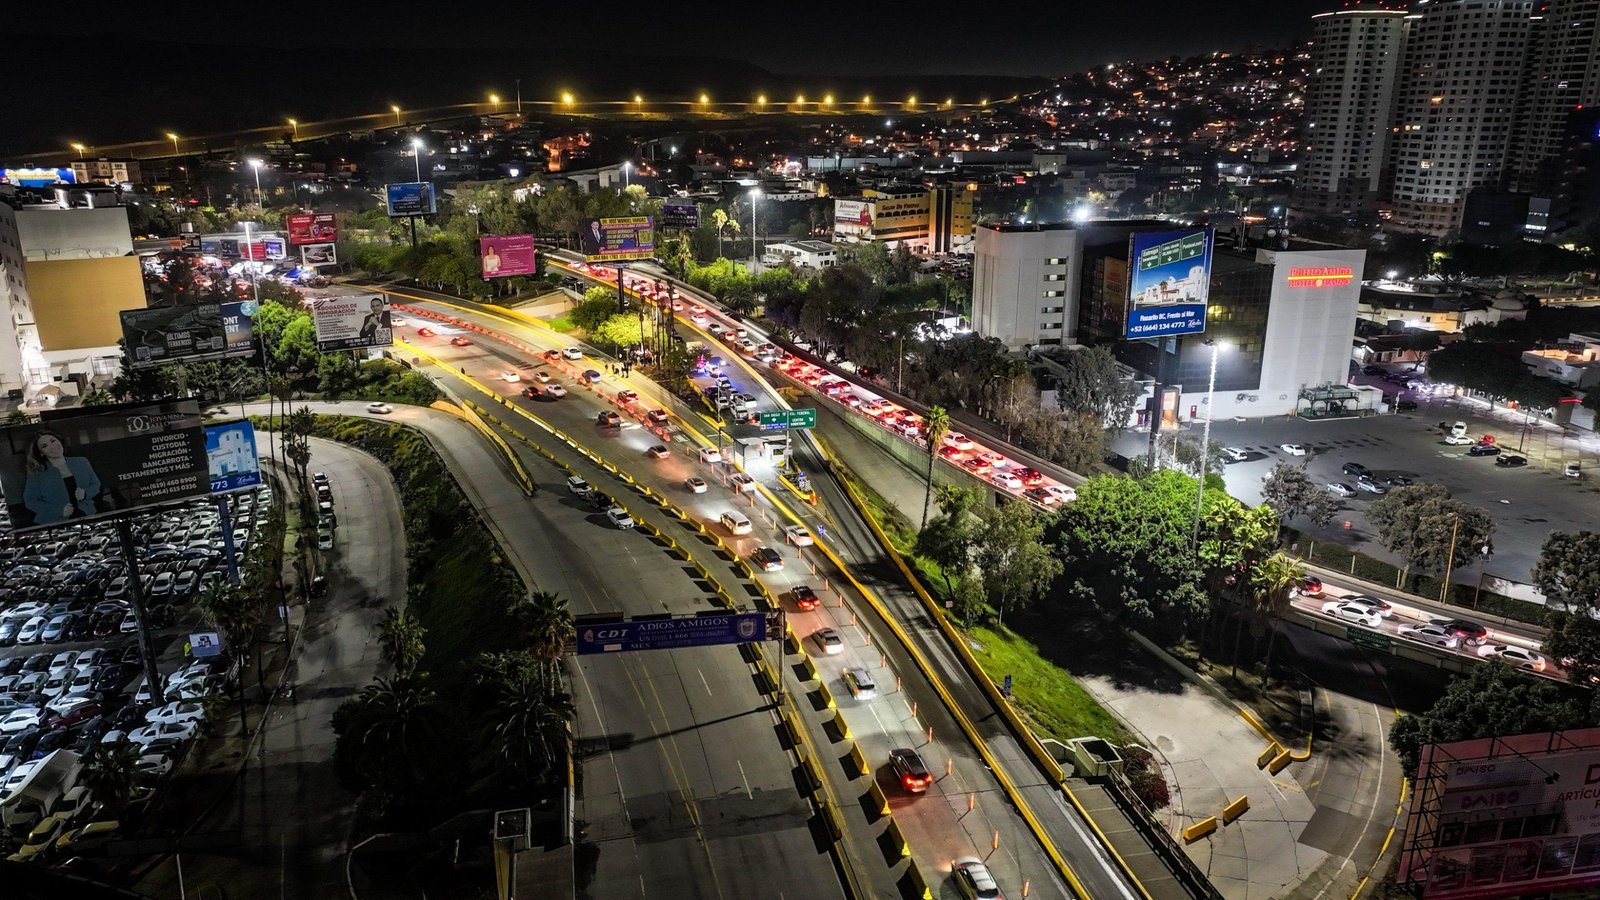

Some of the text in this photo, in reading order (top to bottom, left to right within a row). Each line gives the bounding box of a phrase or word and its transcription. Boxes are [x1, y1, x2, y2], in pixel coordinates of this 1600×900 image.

[1291, 267, 1352, 276] PUEBLO AMIGO
[152, 432, 186, 444] DIVORCIO
[152, 441, 187, 452] CUSTODIA
[149, 448, 188, 460] MIGRACIÓN
[142, 456, 190, 469] BANCARROTA
[118, 467, 170, 481] TESTAMENTOS
[176, 462, 191, 470] MÁS
[150, 482, 167, 492] (619)
[180, 476, 197, 485] 8900
[211, 480, 228, 490] 773
[638, 622, 675, 631] ADIOS
[678, 617, 729, 629] AMIGOS
[597, 629, 629, 639] CDT
[1456, 764, 1496, 775] DAISO
[1461, 791, 1520, 808] DAISO
